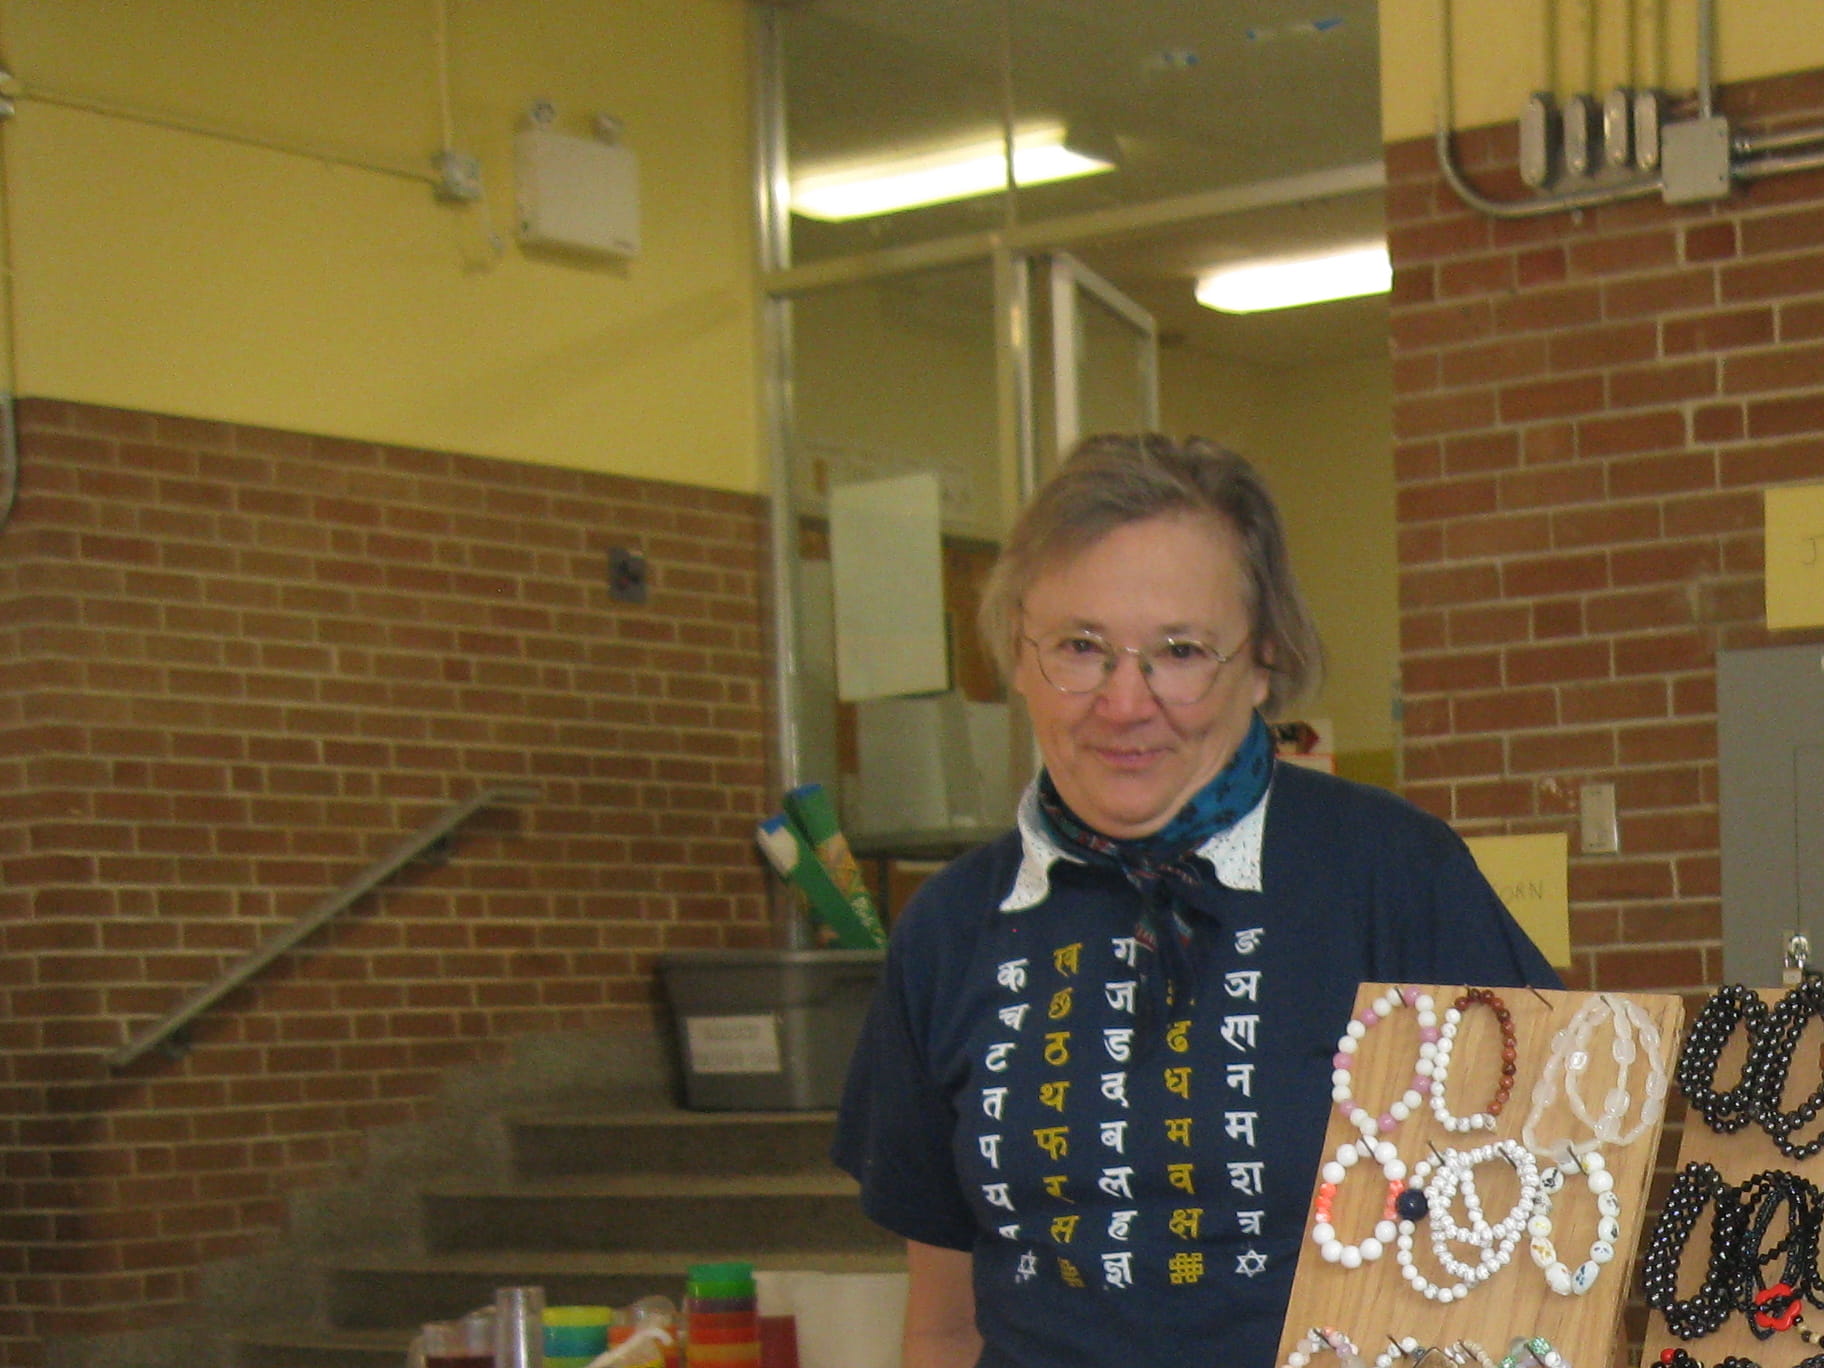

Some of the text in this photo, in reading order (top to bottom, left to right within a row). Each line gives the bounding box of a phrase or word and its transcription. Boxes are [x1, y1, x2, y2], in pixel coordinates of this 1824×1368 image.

[997, 957, 1030, 993] क
[1105, 980, 1137, 1015] ज
[985, 1042, 1017, 1073] ट
[1043, 1031, 1071, 1067] ठ
[1103, 1027, 1135, 1063] ड
[981, 1086, 1009, 1121] त
[1226, 1063, 1256, 1098] न
[978, 1133, 1003, 1170] प
[1032, 1125, 1070, 1161] फ
[1223, 1110, 1260, 1148] म
